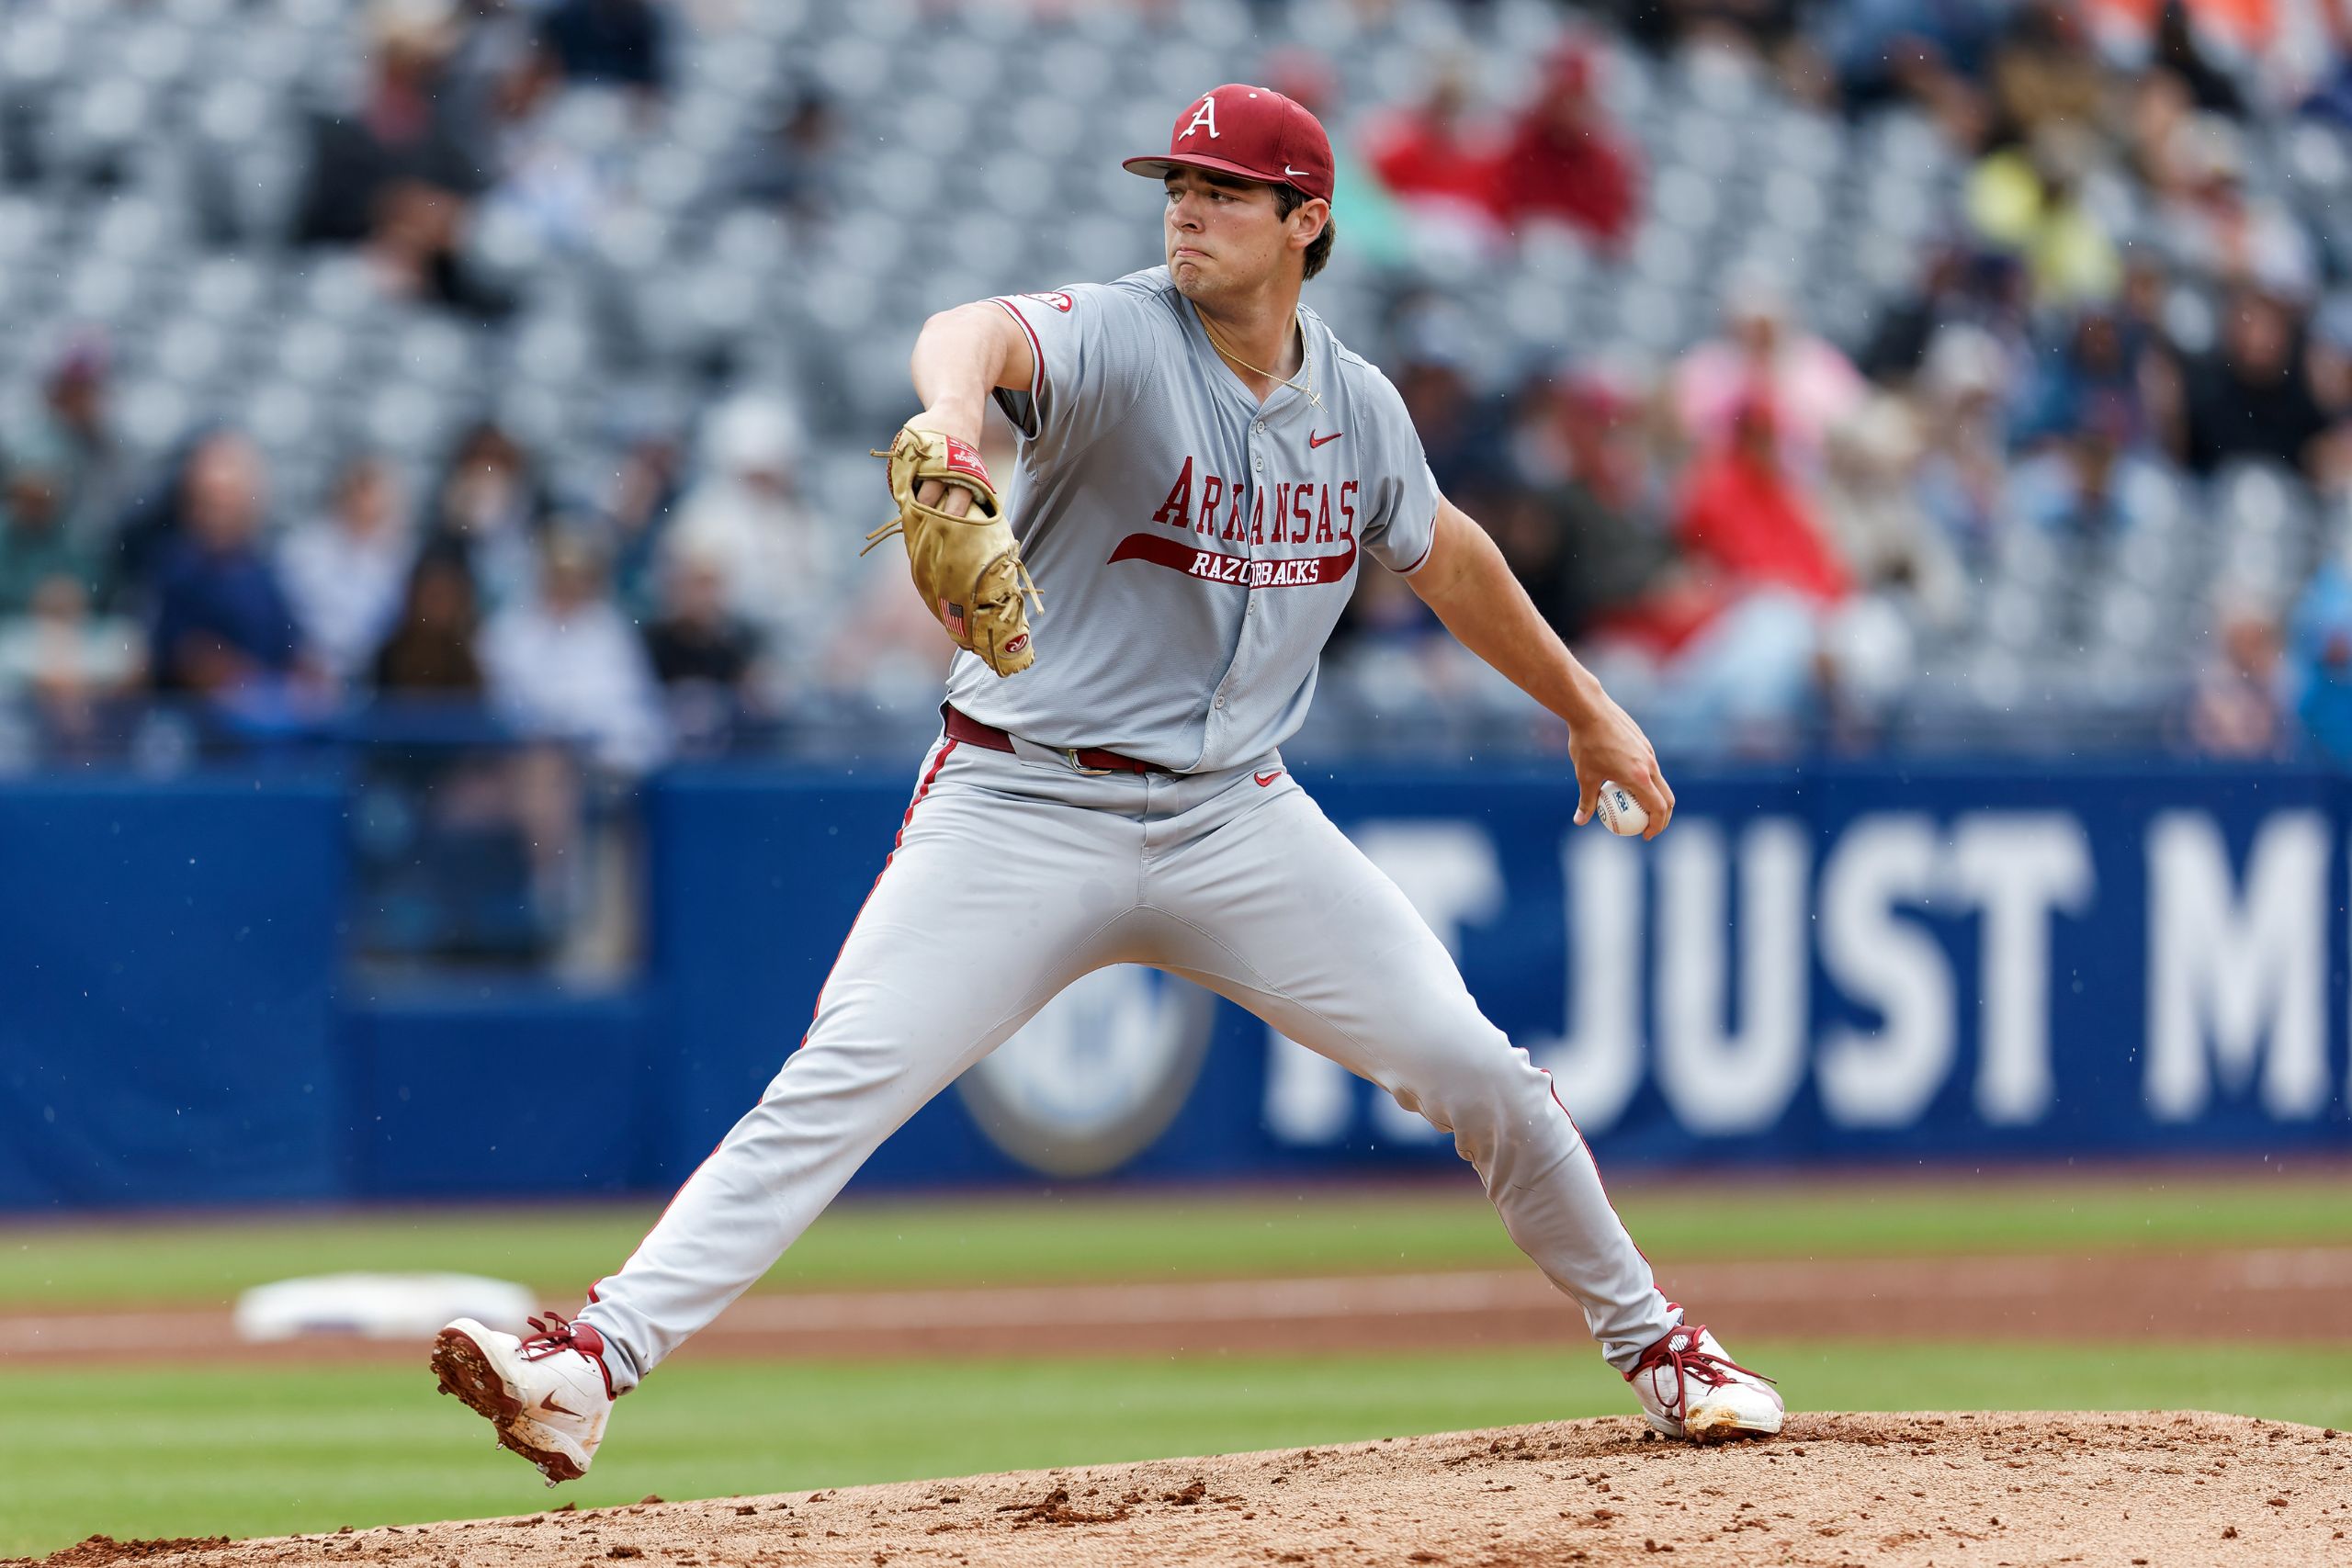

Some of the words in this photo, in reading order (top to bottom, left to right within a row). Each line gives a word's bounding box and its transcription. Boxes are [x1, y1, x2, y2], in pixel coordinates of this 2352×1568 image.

[1178, 96, 1220, 141] A
[1151, 456, 1359, 546] ARKANSAS
[1188, 551, 1320, 588] RAZORBACKS
[1527, 808, 2092, 1139] JUST
[2142, 807, 2352, 1124] M
